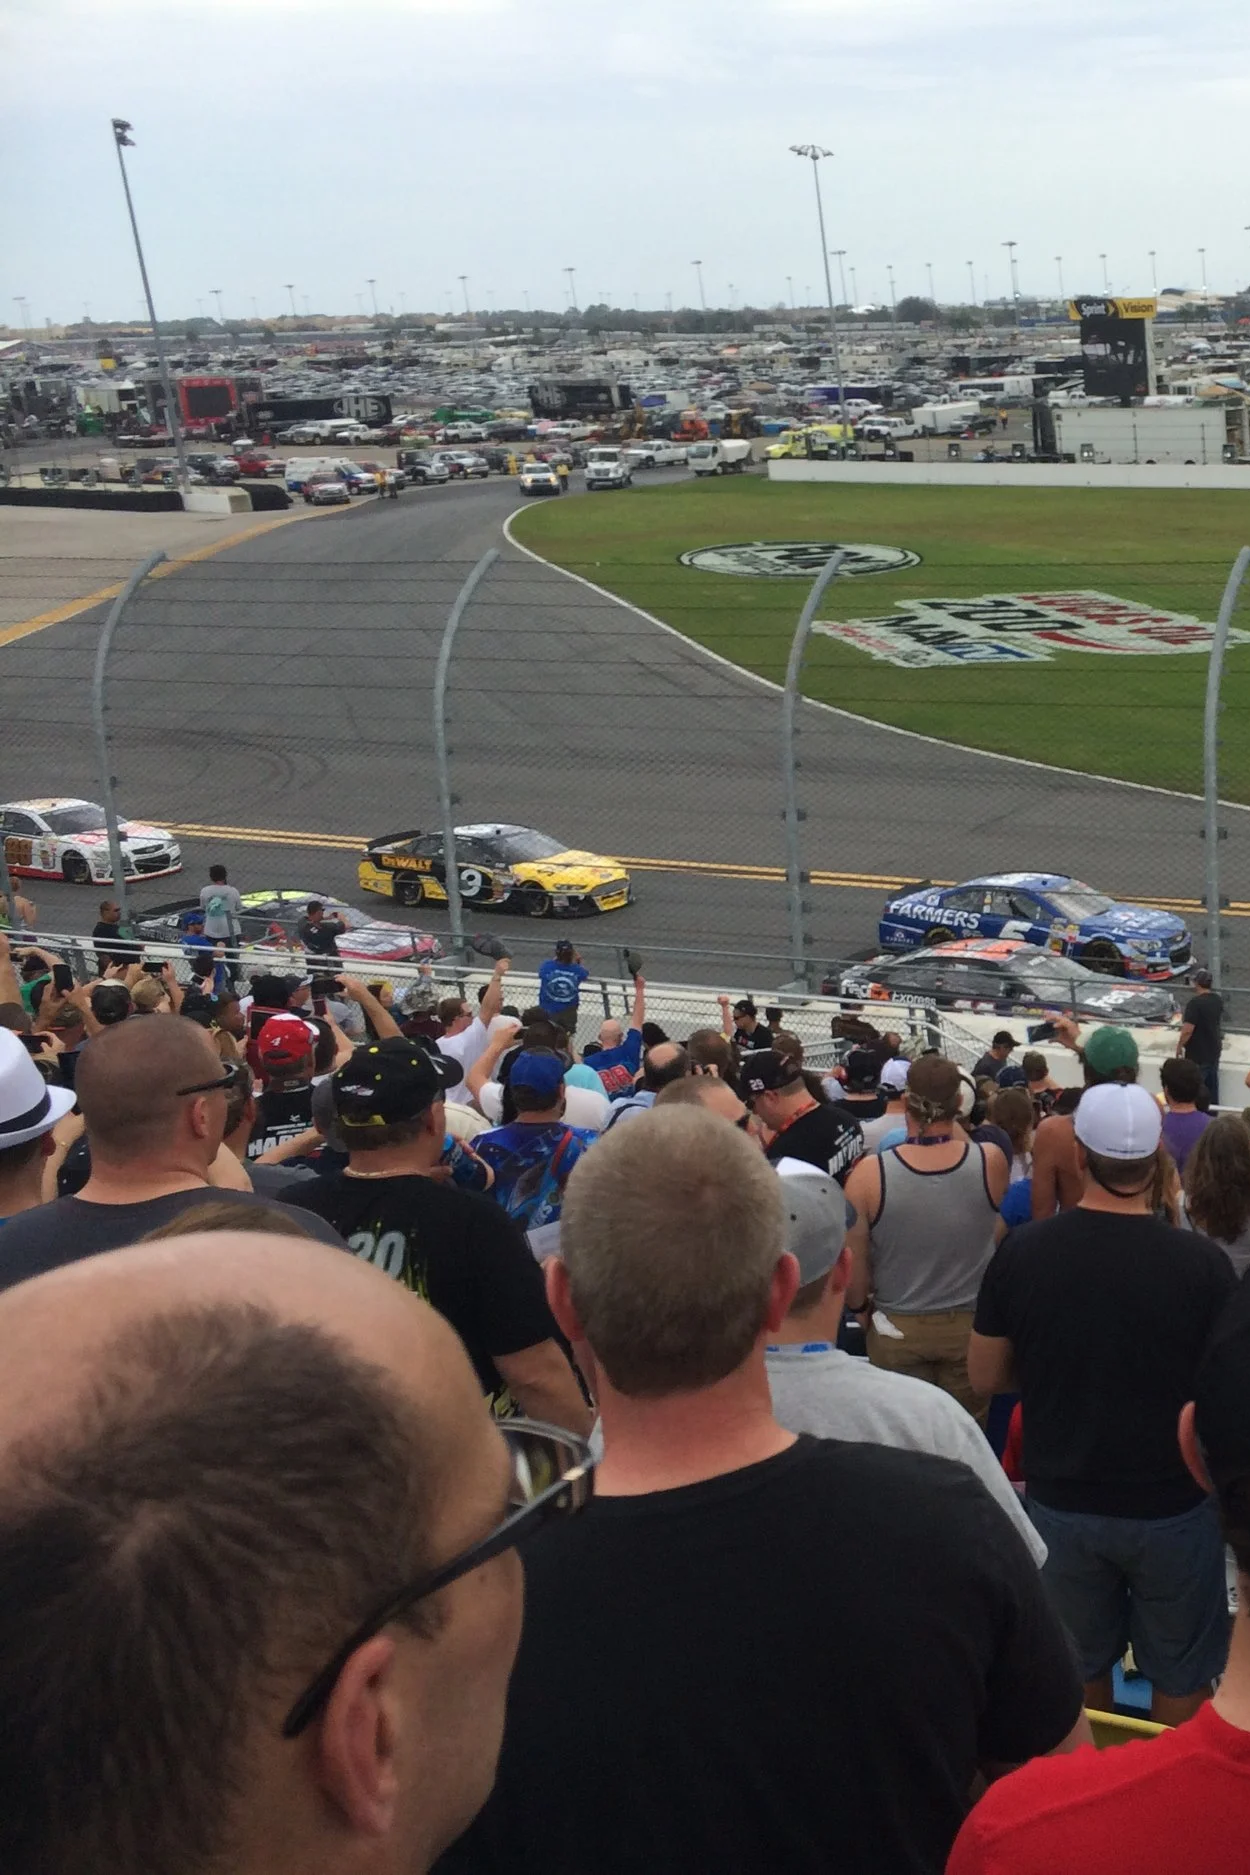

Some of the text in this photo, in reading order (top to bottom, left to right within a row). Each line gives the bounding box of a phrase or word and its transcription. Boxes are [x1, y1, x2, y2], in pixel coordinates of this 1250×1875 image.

[1081, 302, 1154, 317] Sprint Vision
[919, 600, 1086, 632] 200
[460, 869, 482, 896] 9
[890, 900, 981, 929] FARMERS
[749, 1078, 765, 1091] 29
